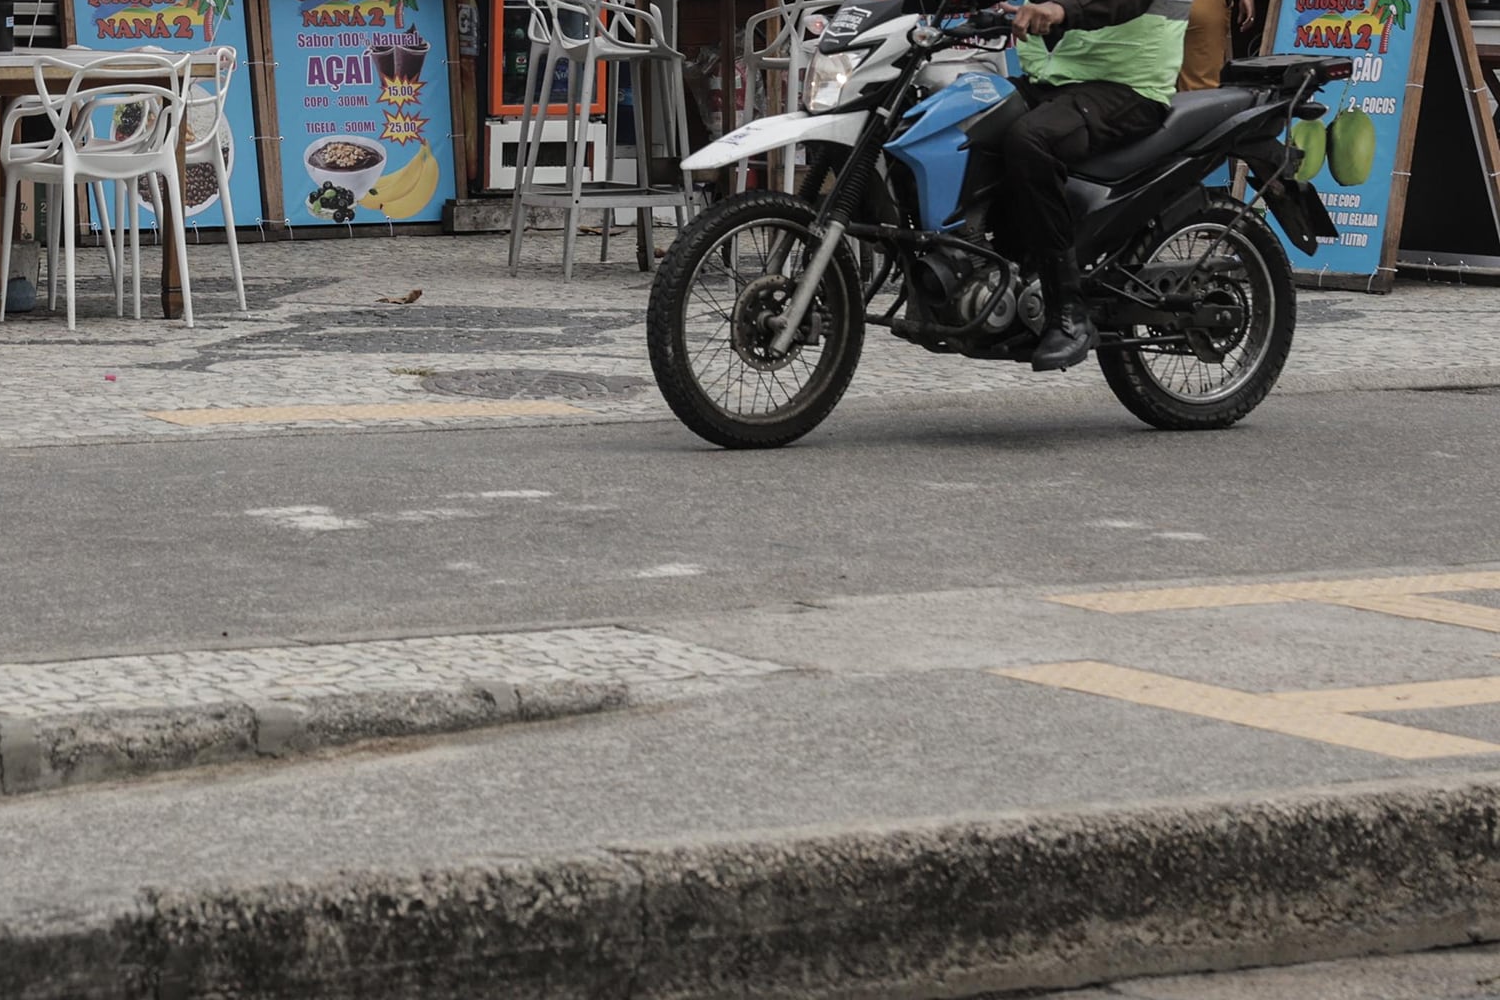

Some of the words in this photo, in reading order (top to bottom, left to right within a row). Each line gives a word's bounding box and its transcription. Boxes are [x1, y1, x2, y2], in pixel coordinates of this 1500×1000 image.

[302, 4, 367, 28] NANÁ
[96, 12, 171, 39] NANÁ
[1294, 20, 1354, 49] NANÁ
[297, 32, 335, 47] Sabor
[338, 32, 371, 47] 100%
[372, 30, 419, 47] Natural
[307, 49, 374, 91] AÇAÍ
[1351, 52, 1384, 86] ÇÃO
[303, 96, 330, 108] COPO
[337, 95, 370, 107] 300ML
[1347, 95, 1357, 113] 2
[1361, 96, 1397, 115] COCOS
[306, 122, 337, 134] TIGELA
[344, 121, 377, 133] 500ML
[1327, 193, 1339, 207] DE
[1339, 194, 1362, 208] COCO
[1336, 212, 1349, 225] OU
[1349, 213, 1379, 227] GELADA
[1340, 234, 1346, 246] 1
[1345, 233, 1368, 247] LITRO
